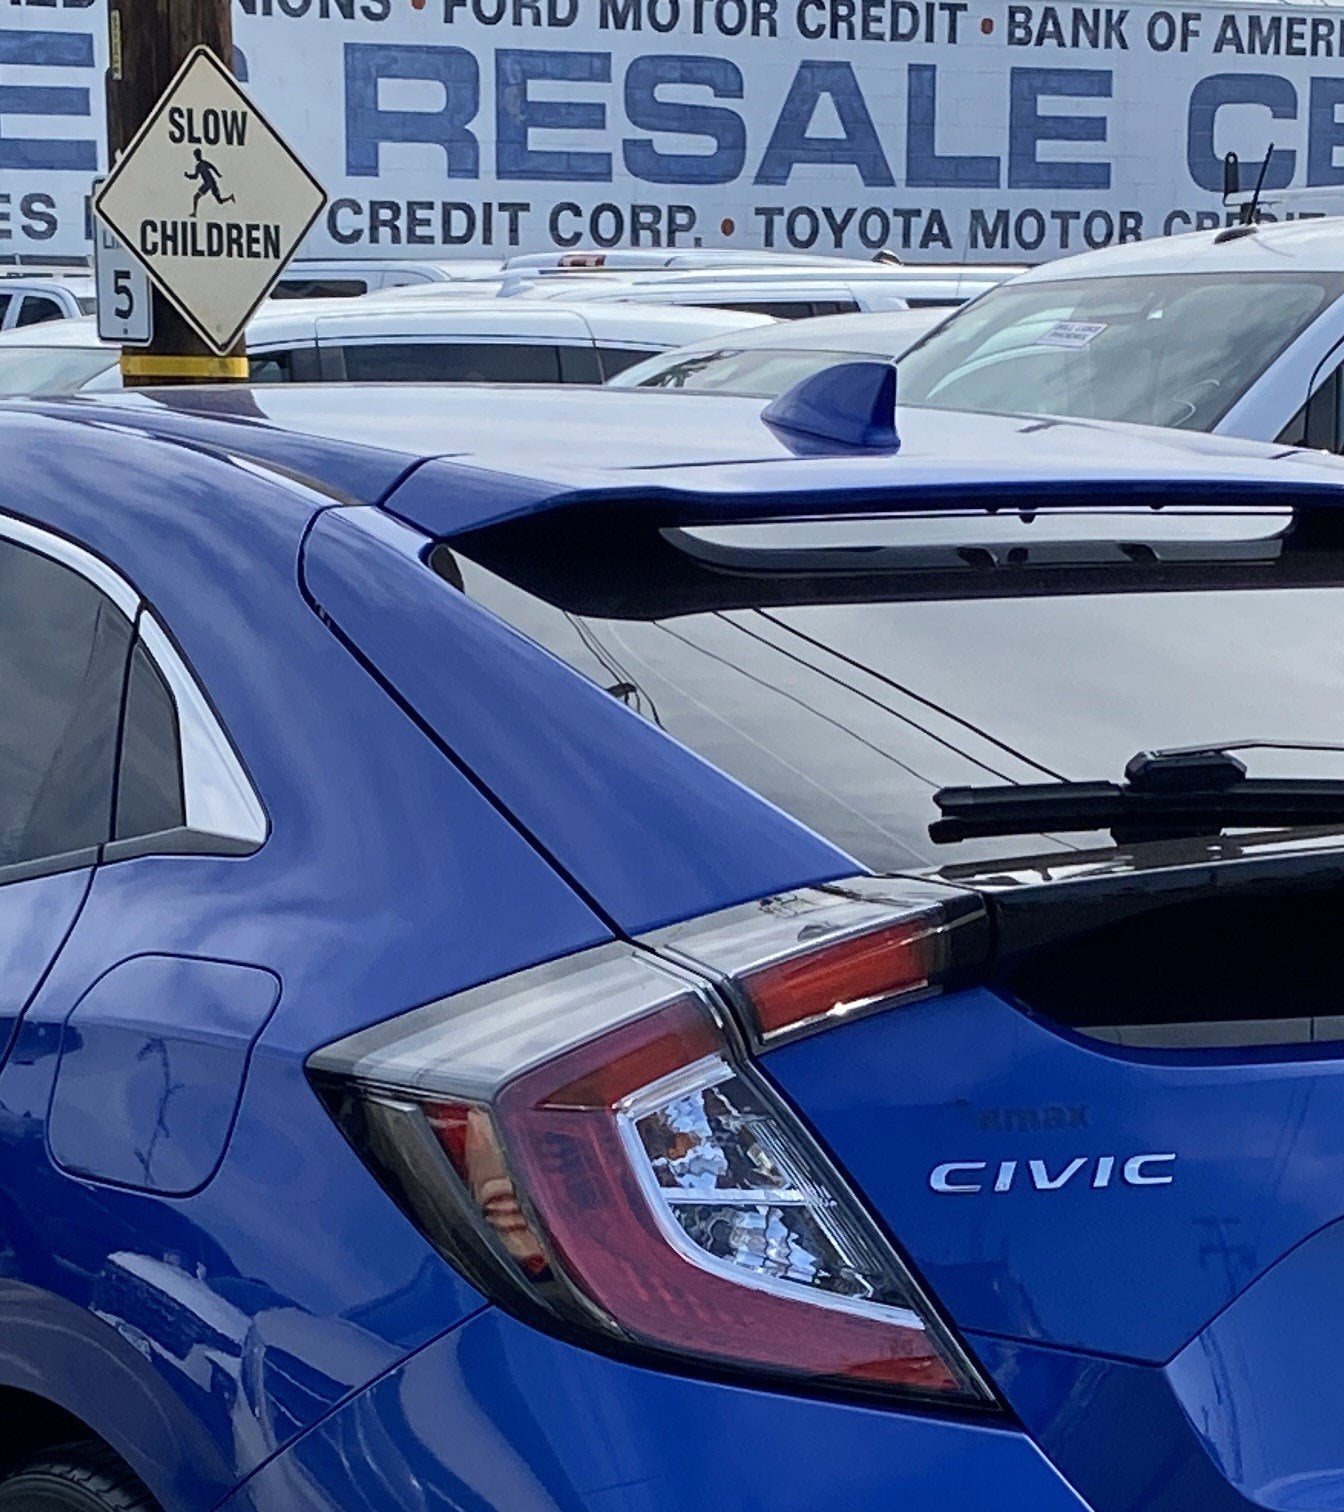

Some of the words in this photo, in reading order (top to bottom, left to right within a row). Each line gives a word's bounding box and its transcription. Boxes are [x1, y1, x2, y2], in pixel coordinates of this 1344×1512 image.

[598, 0, 778, 38] MOTOR
[796, 0, 968, 44] CREDIT
[1007, 4, 1129, 50] BANK
[1146, 10, 1202, 54] OF
[168, 107, 248, 147] SLOW
[343, 42, 1113, 190] RESALE
[140, 219, 281, 260] CHILDREN
[327, 198, 530, 246] CREDIT
[549, 200, 703, 249] CORP.
[756, 205, 954, 250] TOYOTA
[969, 208, 1144, 251] MOTOR
[114, 269, 134, 320] 5
[929, 1152, 1177, 1193] CIVIC
